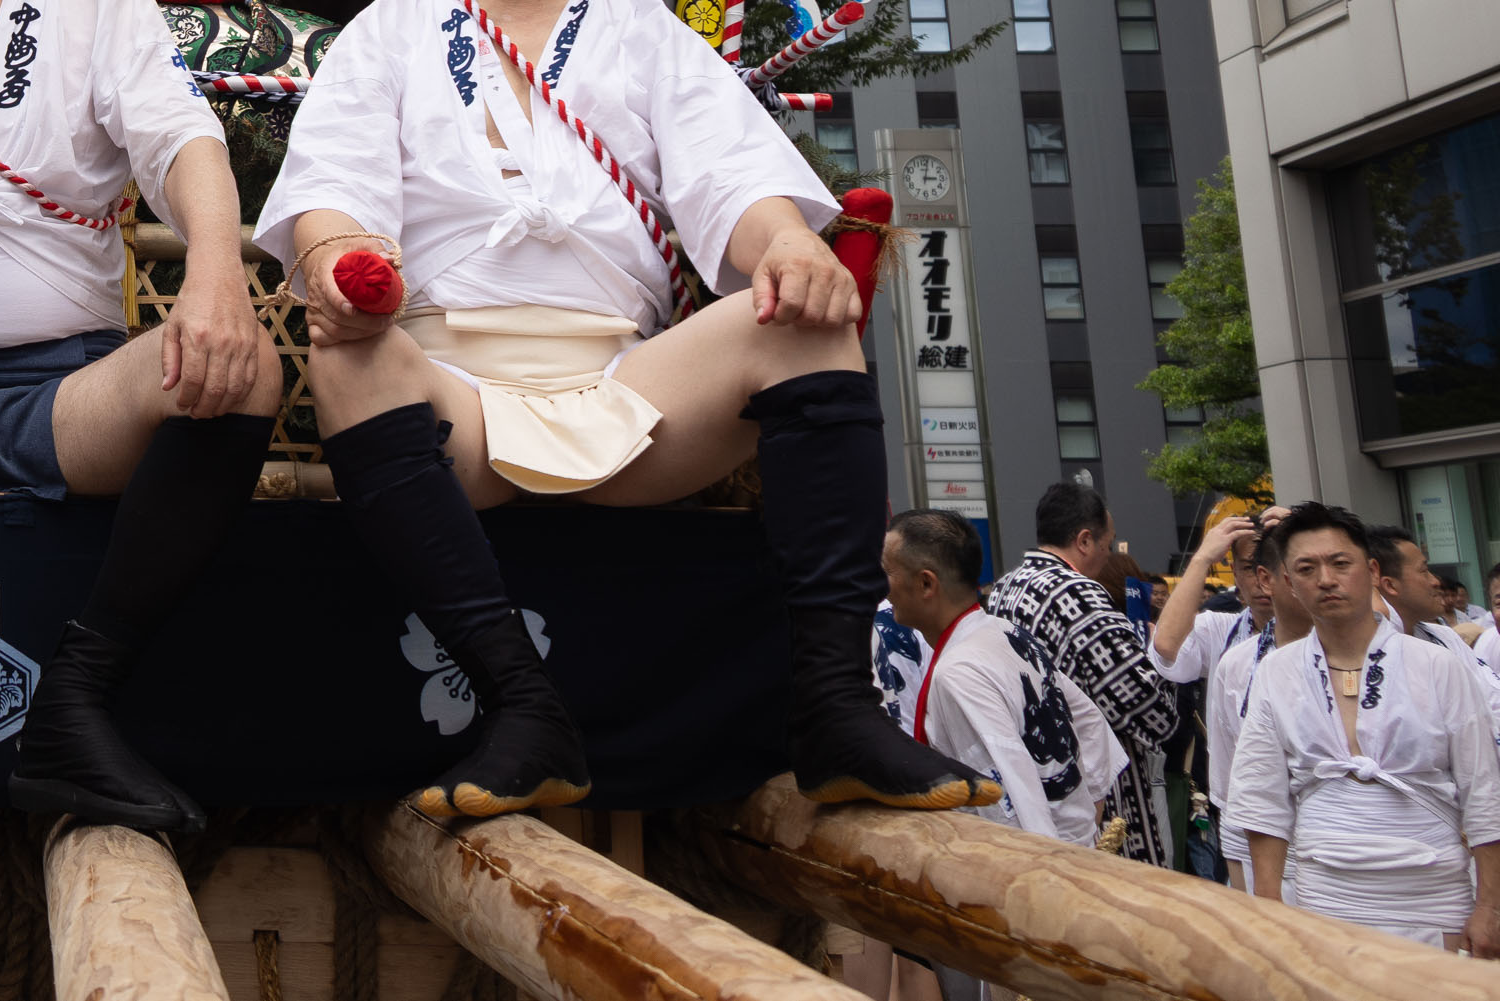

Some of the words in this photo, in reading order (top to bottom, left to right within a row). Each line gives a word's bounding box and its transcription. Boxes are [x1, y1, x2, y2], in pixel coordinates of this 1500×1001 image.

[918, 230, 954, 342] オオモリ
[916, 344, 970, 370] 総建
[939, 421, 978, 431] 日新火災
